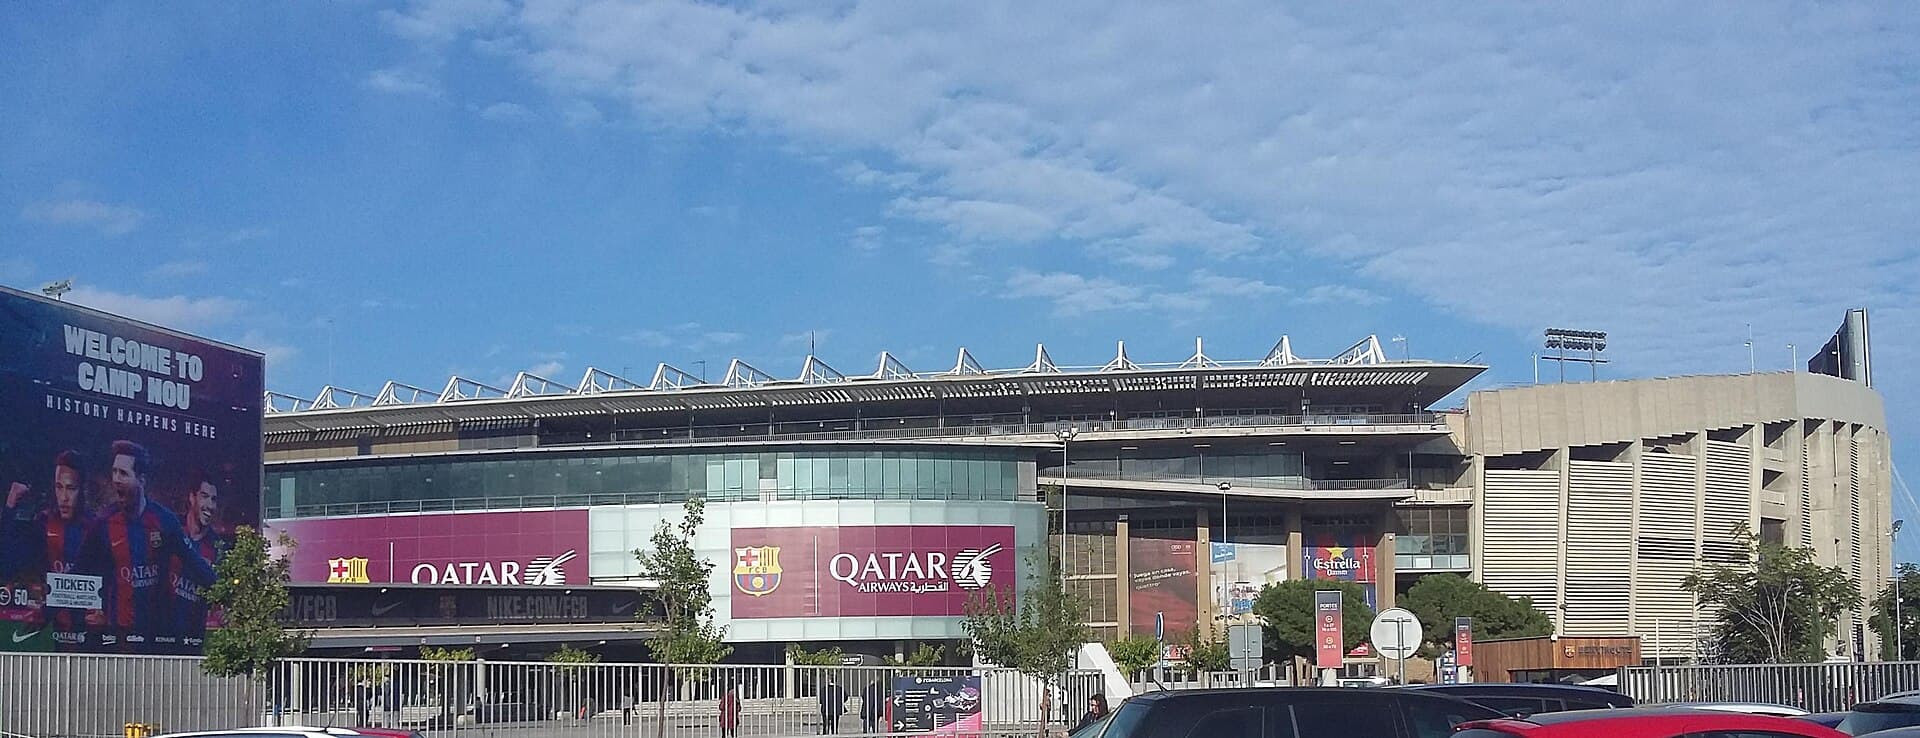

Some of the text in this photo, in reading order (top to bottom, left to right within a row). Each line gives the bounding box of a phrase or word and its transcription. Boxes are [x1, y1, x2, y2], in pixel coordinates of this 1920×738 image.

[64, 324, 203, 382] WELCOME TO
[78, 362, 190, 410] CAMP NOU
[47, 394, 216, 439] HISTORY HAPPENS HERE
[120, 563, 158, 582] QATAR
[829, 552, 949, 587] QATAR
[1313, 557, 1361, 570] Estrella
[54, 577, 96, 592] TICKETS
[857, 581, 909, 593] AIRWAYS
[14, 589, 28, 606] 50
[487, 595, 588, 620] NIKE.COM/FCB
[52, 631, 77, 641] QATAR
